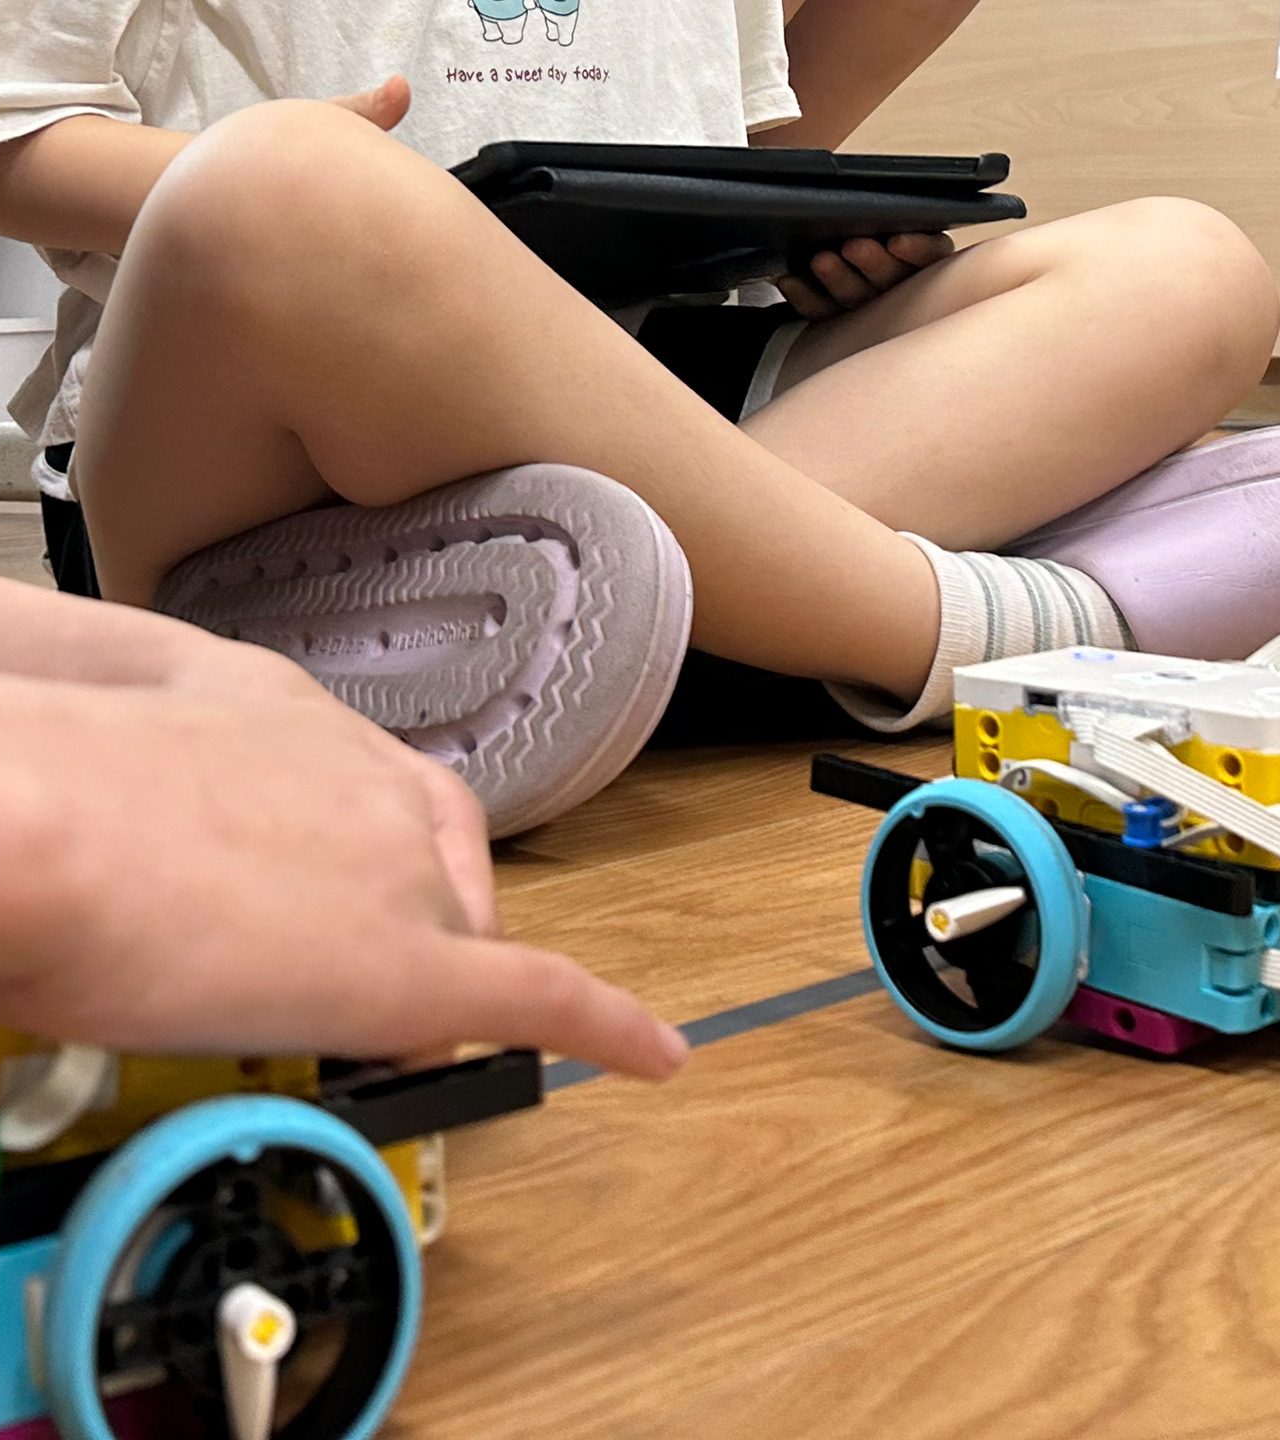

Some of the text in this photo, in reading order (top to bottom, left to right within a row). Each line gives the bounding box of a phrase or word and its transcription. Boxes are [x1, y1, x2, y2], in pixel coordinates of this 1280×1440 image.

[446, 67, 484, 83] Have
[489, 68, 498, 82] a
[505, 67, 542, 82] sweet
[547, 64, 567, 84] day
